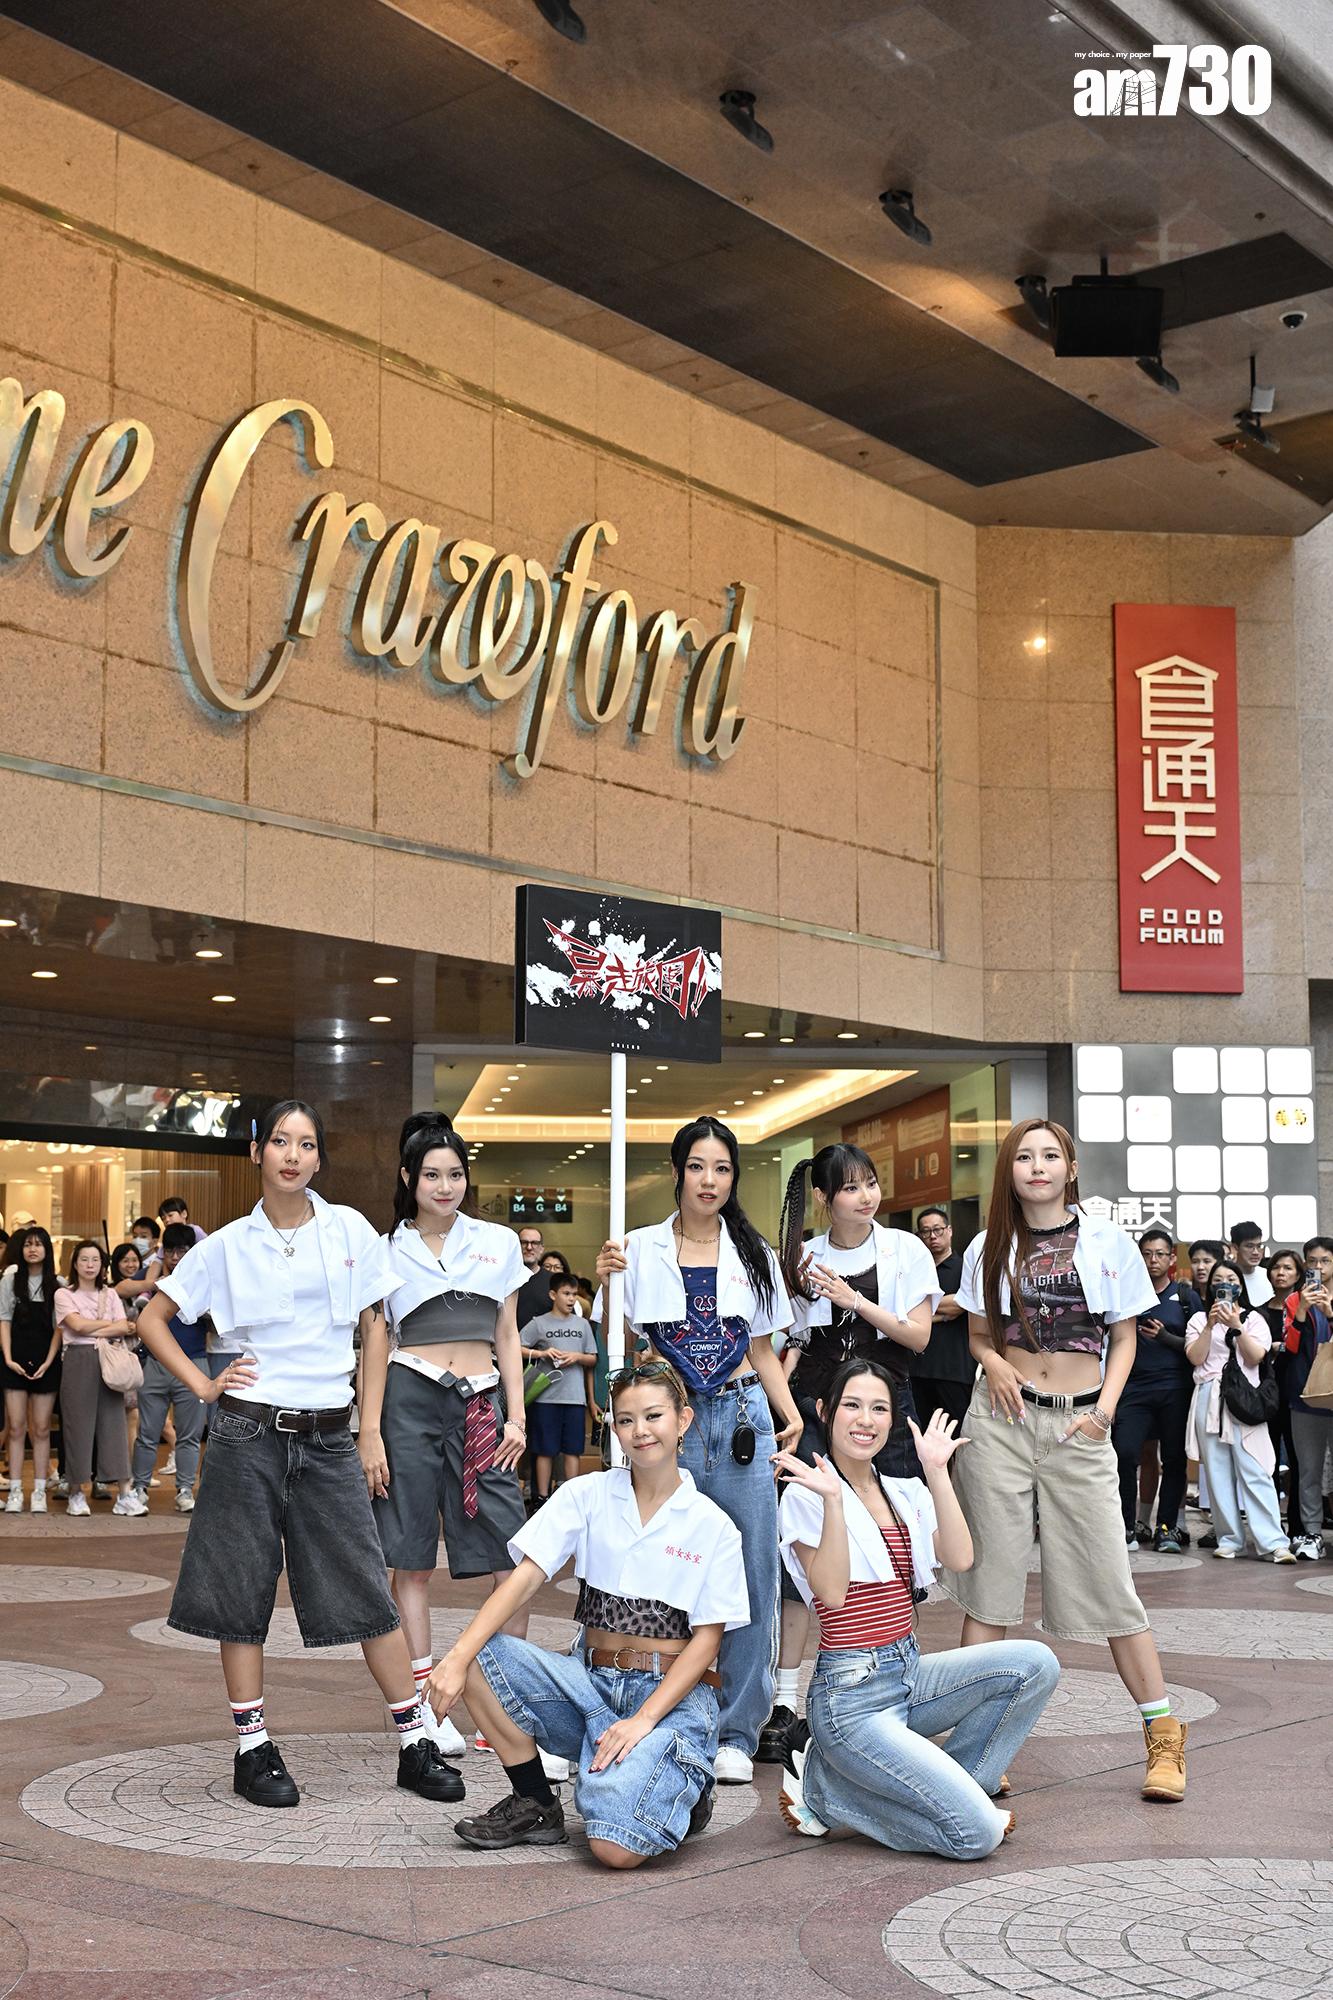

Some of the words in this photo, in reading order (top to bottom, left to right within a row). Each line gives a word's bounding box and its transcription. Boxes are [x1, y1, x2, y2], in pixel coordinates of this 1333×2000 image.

[177, 398, 760, 779] Crawford
[1134, 654, 1220, 885] 食通天
[1139, 907, 1224, 924] FOOD
[1139, 927, 1224, 945] FORUM
[513, 1203, 525, 1212] B4
[536, 1203, 545, 1212] G
[554, 1203, 567, 1212] B4
[545, 1328, 583, 1339] adidas
[691, 1343, 721, 1352] COWBOY
